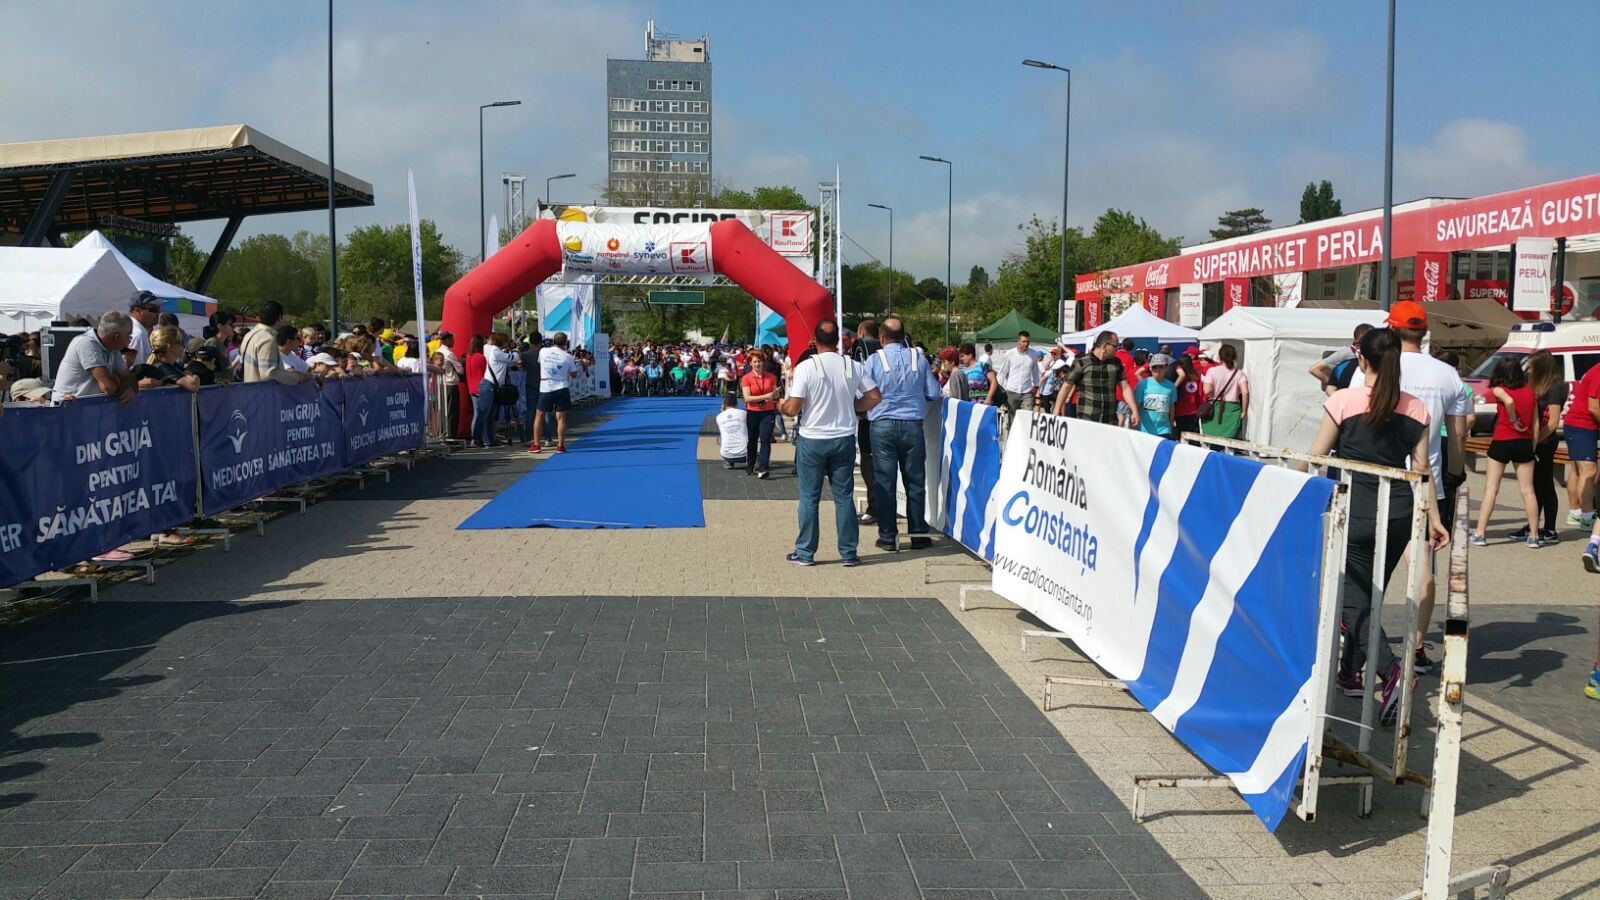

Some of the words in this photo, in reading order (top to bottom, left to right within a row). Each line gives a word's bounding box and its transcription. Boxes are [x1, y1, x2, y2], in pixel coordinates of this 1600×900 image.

[1437, 198, 1534, 242] SAVUREAZĂ
[1542, 192, 1600, 226] GUST
[634, 252, 667, 260] synevo
[1193, 238, 1307, 280] SUPERMARKET
[1317, 225, 1384, 263] PERLA
[1519, 268, 1547, 279] PERLA
[280, 409, 294, 422] DIN
[295, 399, 321, 423] GRIJĂ
[390, 409, 407, 420] PENTRU
[76, 441, 101, 464] DIN
[105, 420, 152, 458] GRIJĂ
[287, 426, 315, 441] PENTRU
[268, 444, 320, 471] SĂNĂTATEA
[321, 441, 335, 458] TA!
[88, 461, 140, 492] PENTRU
[212, 458, 264, 490] MEDICOVER
[1022, 447, 1087, 511] România
[36, 487, 150, 543] SĂNĂTATEA
[1002, 490, 1098, 576] Constanța
